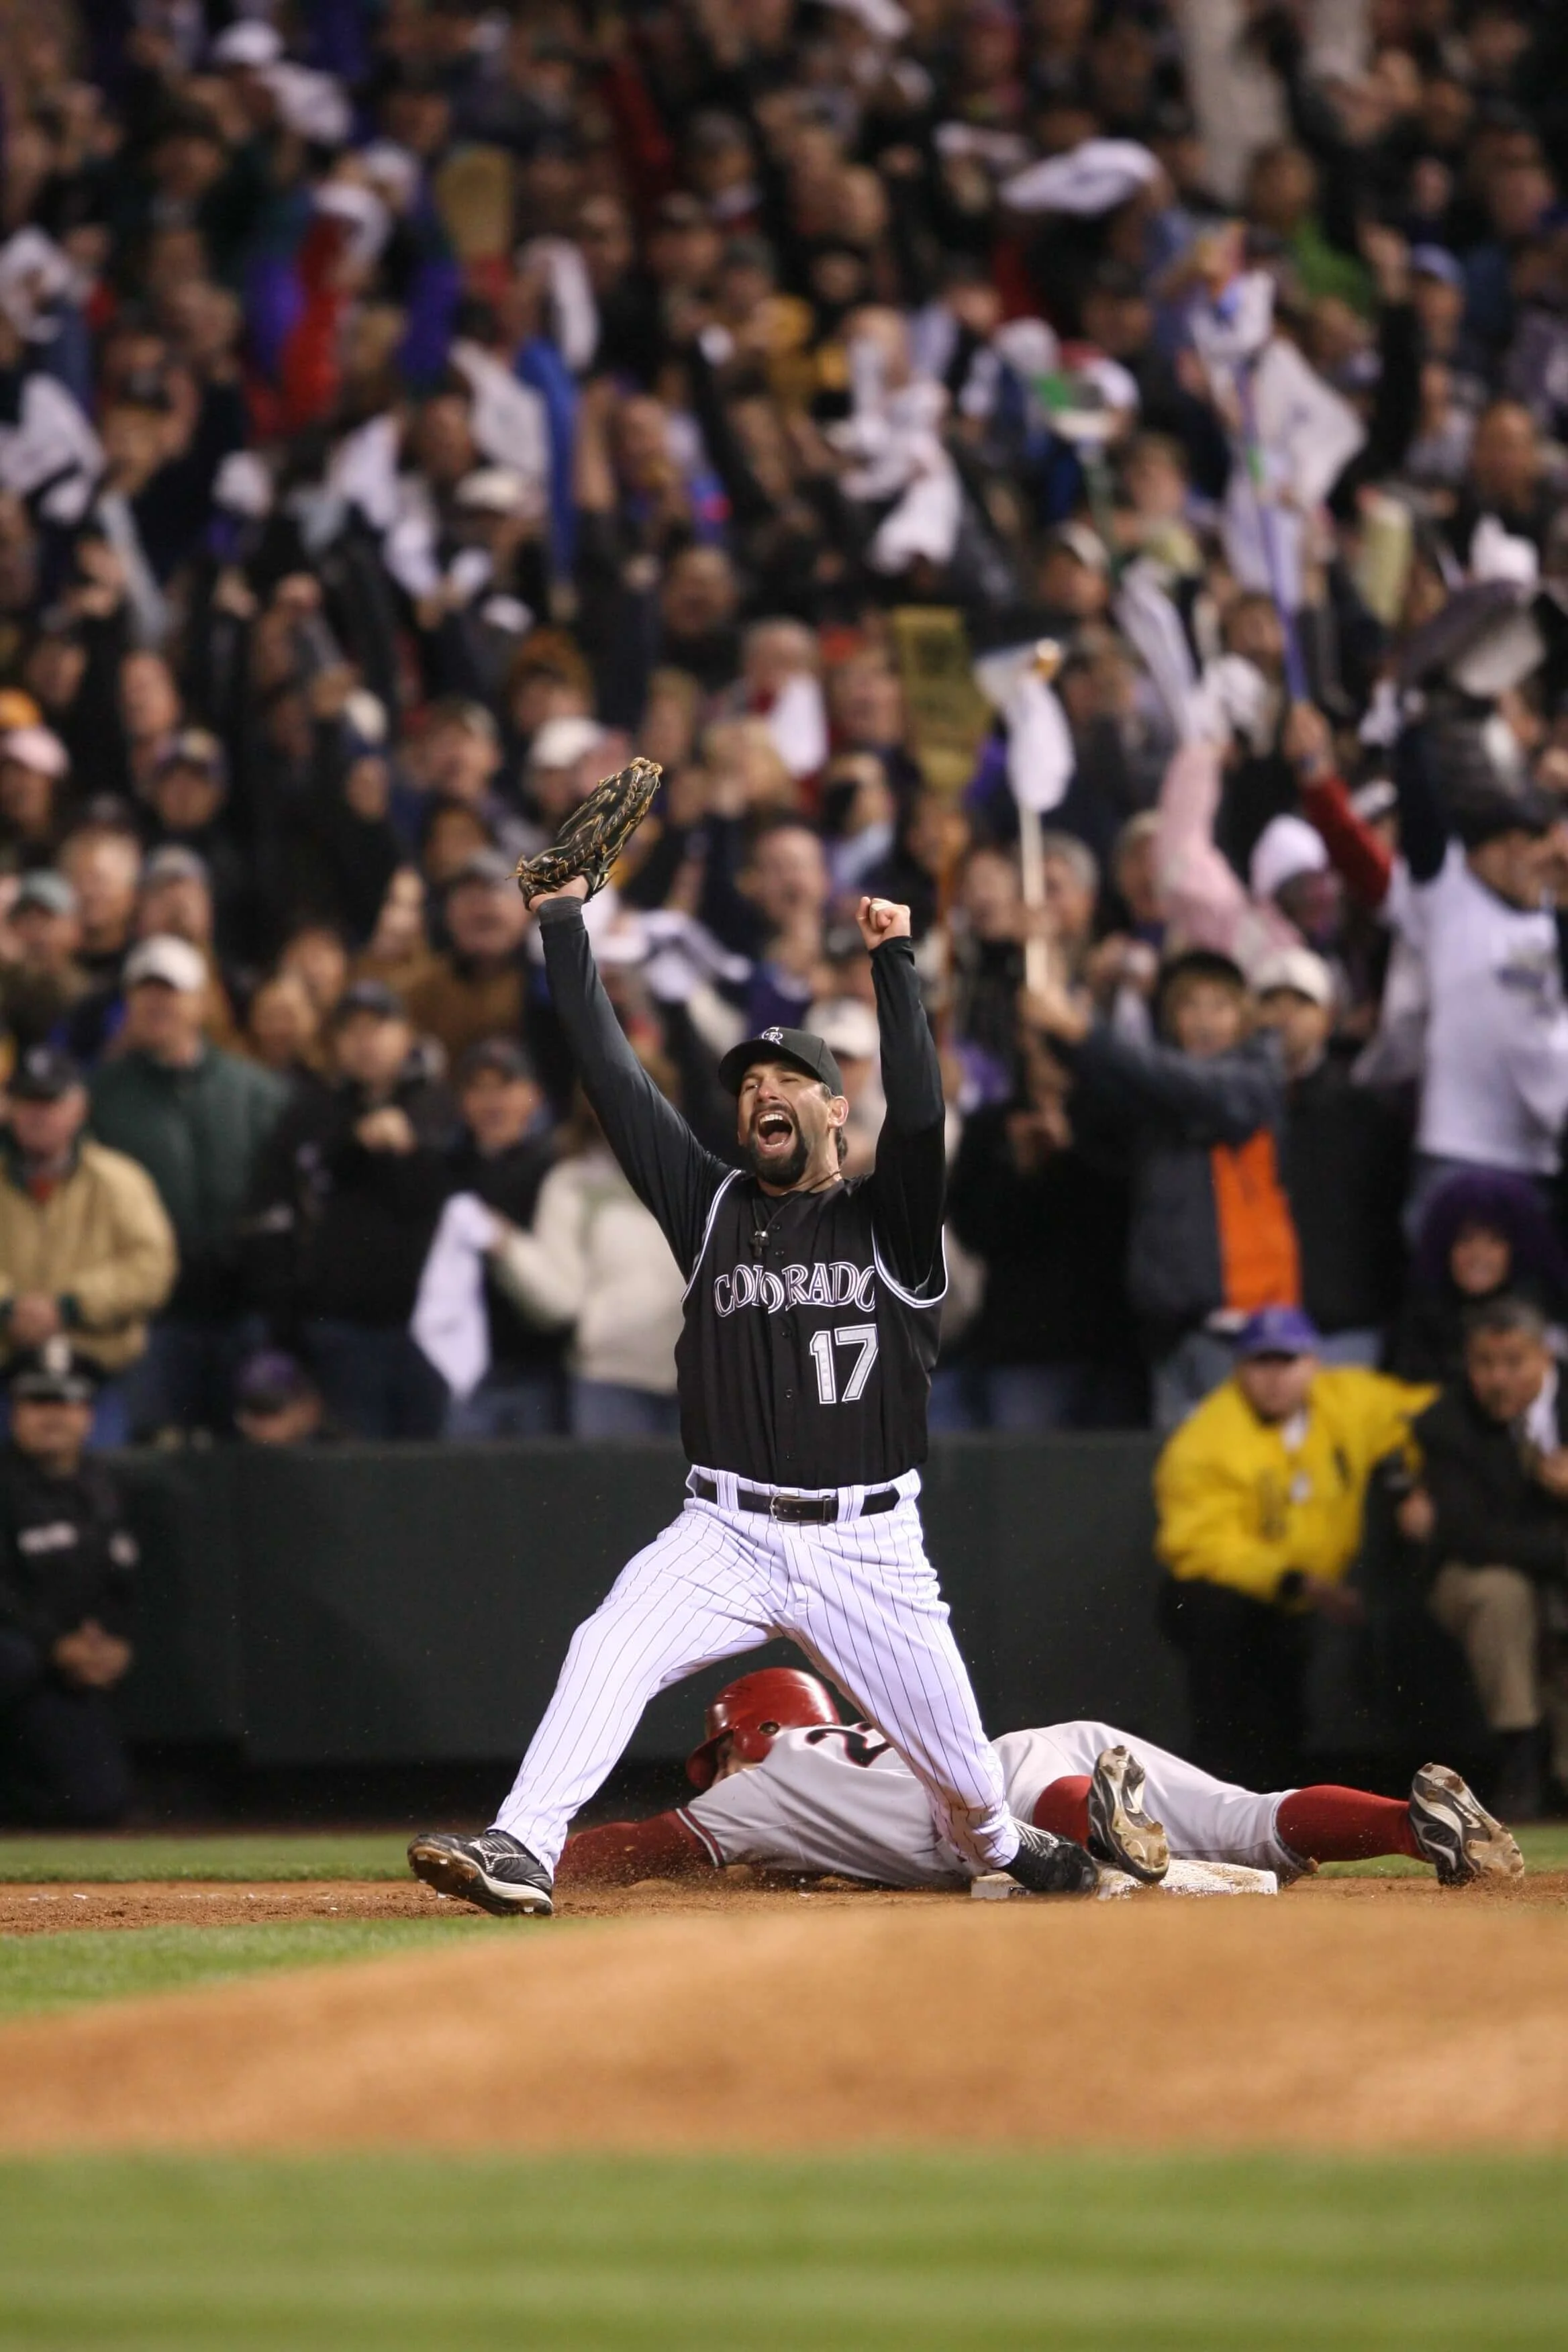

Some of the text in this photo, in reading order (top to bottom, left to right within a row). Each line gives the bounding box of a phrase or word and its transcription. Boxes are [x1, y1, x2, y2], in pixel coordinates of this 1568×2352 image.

[714, 1261, 875, 1318] COLORADO
[809, 1323, 879, 1404] 17
[805, 1721, 891, 1768] 2
